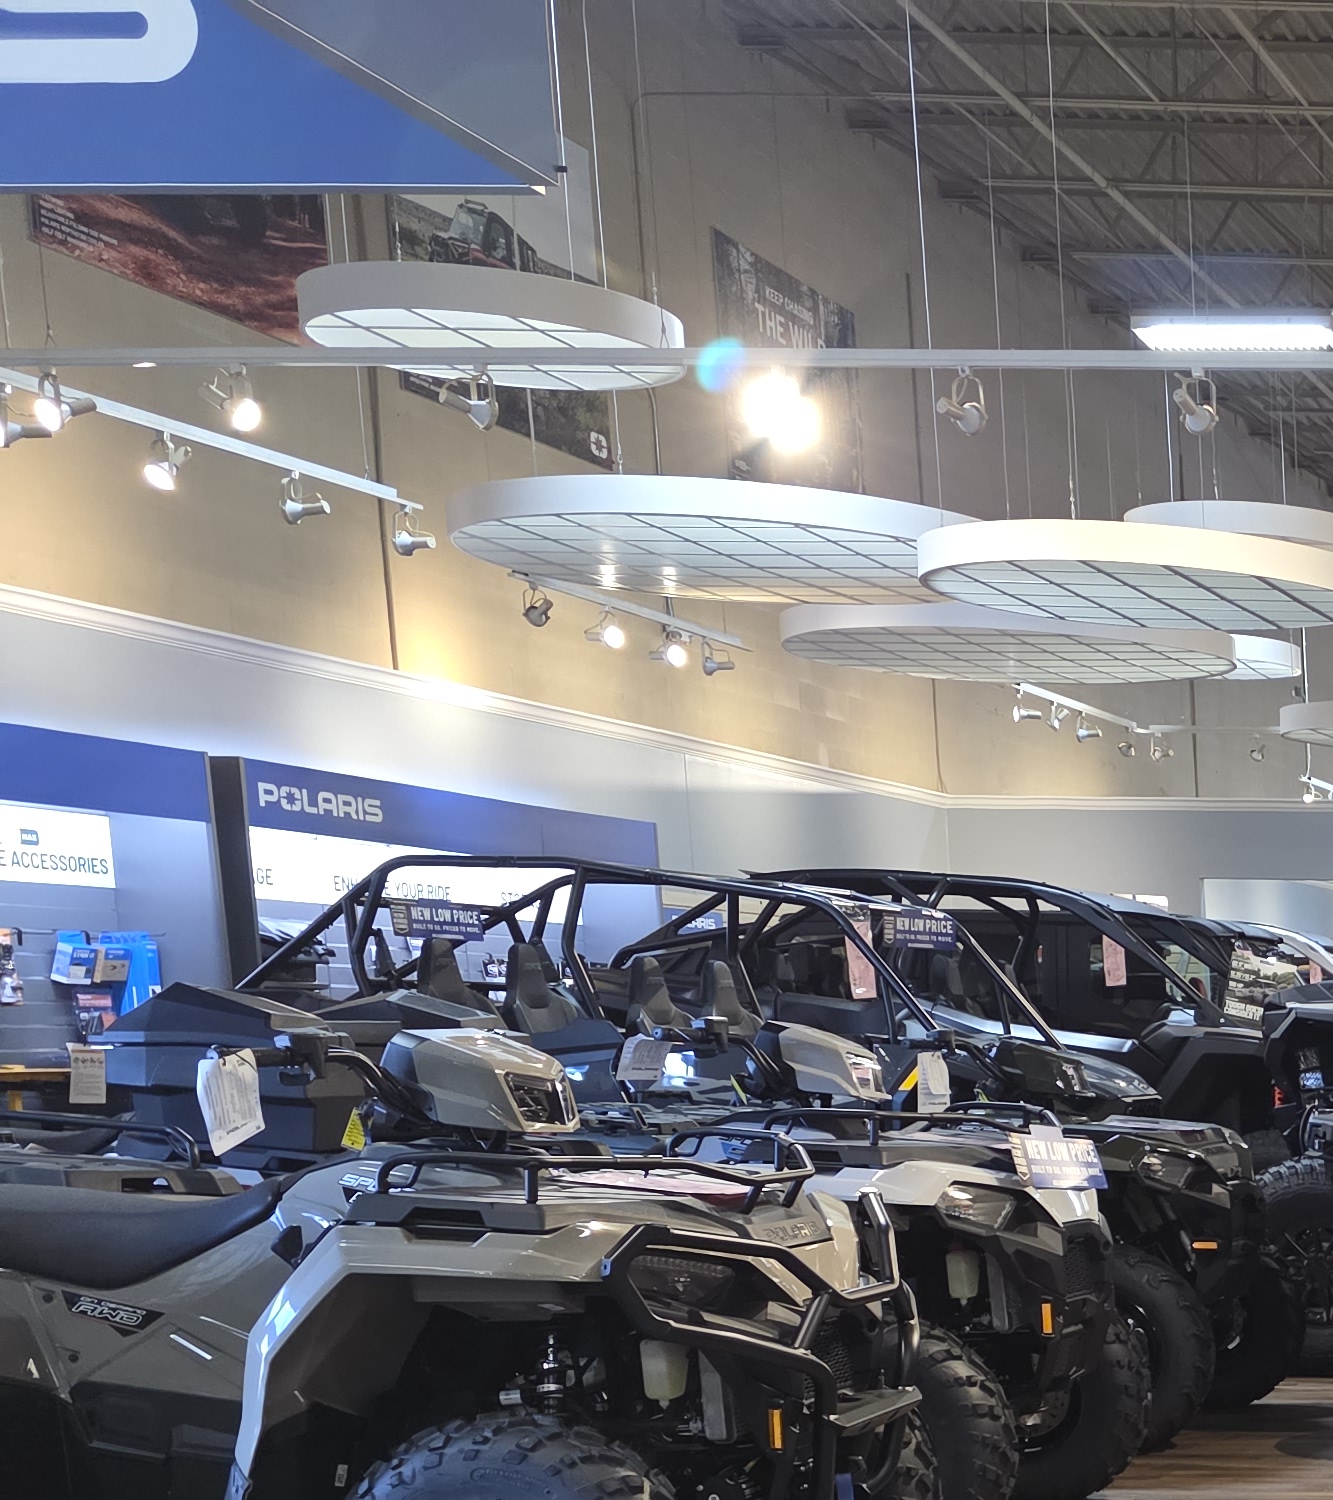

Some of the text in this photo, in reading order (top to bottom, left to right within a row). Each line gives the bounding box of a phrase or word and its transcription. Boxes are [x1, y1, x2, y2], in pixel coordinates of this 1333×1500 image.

[765, 285, 814, 325] KEEP CHASING
[755, 302, 787, 346] THE
[257, 781, 384, 823] POLARIS
[11, 850, 109, 875] ACCESSORIES
[410, 906, 431, 921] NEW
[431, 908, 451, 922] LOW
[452, 909, 479, 925] PRICE
[896, 917, 910, 931] NEW
[910, 918, 925, 932] LOW
[925, 919, 954, 934] PRICE
[1025, 1139, 1047, 1160] NEW
[1047, 1141, 1070, 1162] LOW
[1068, 1143, 1098, 1163] PRICE
[762, 1221, 820, 1242] POLARIS
[71, 1301, 143, 1326] AWD
